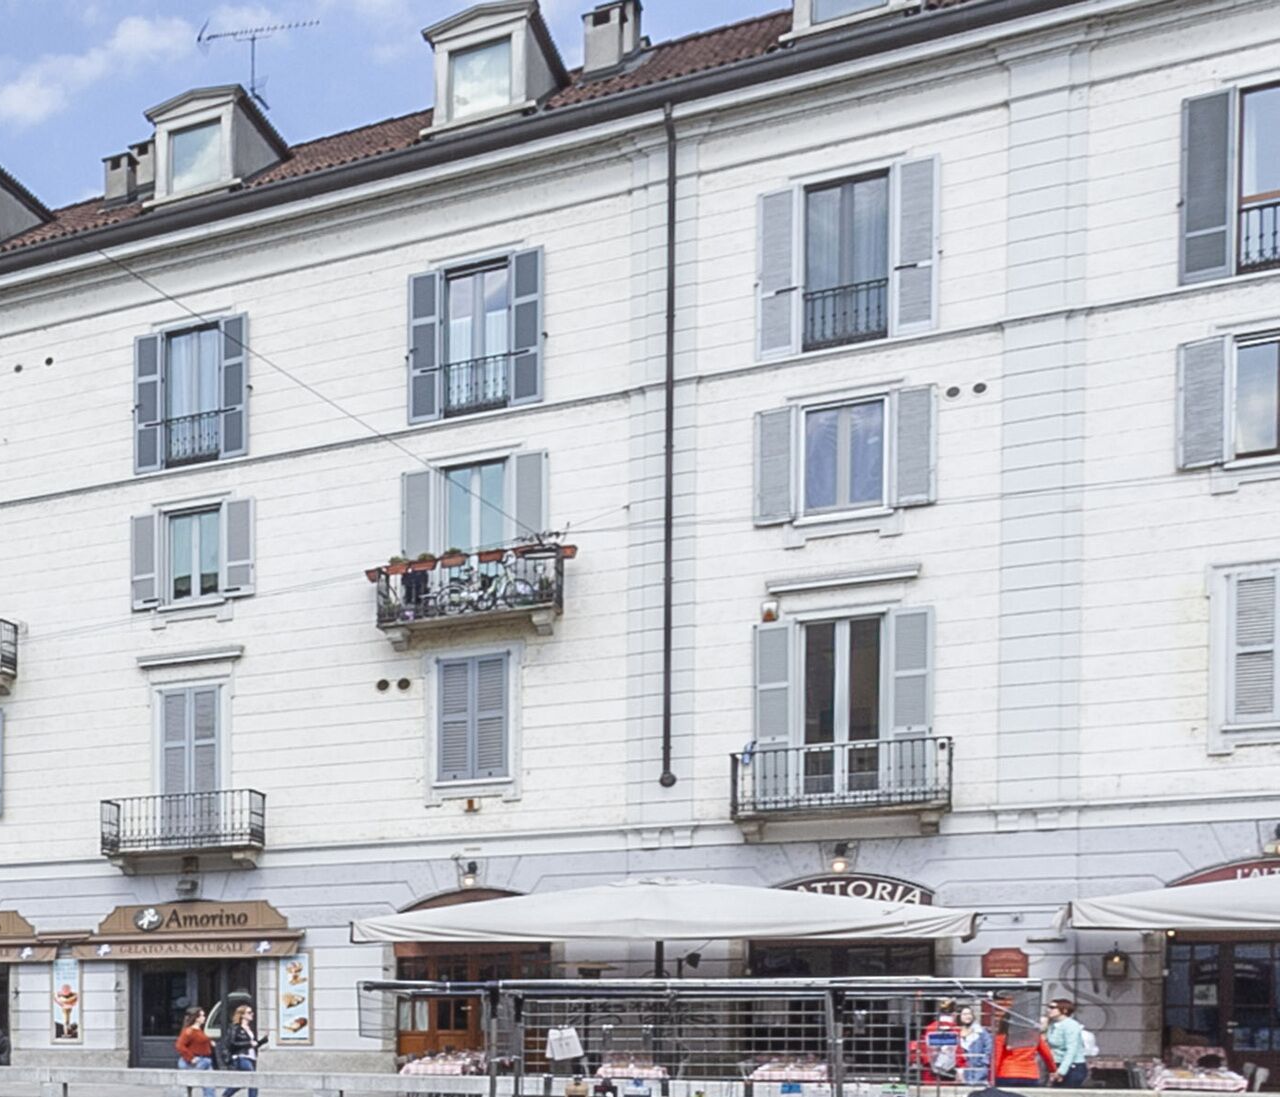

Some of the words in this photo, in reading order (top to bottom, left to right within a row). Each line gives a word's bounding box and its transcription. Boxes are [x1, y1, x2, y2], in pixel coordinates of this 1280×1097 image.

[165, 908, 249, 929] Amorino
[119, 944, 163, 954] GELATO
[164, 944, 180, 953] AL
[181, 942, 244, 953] NATURALE
